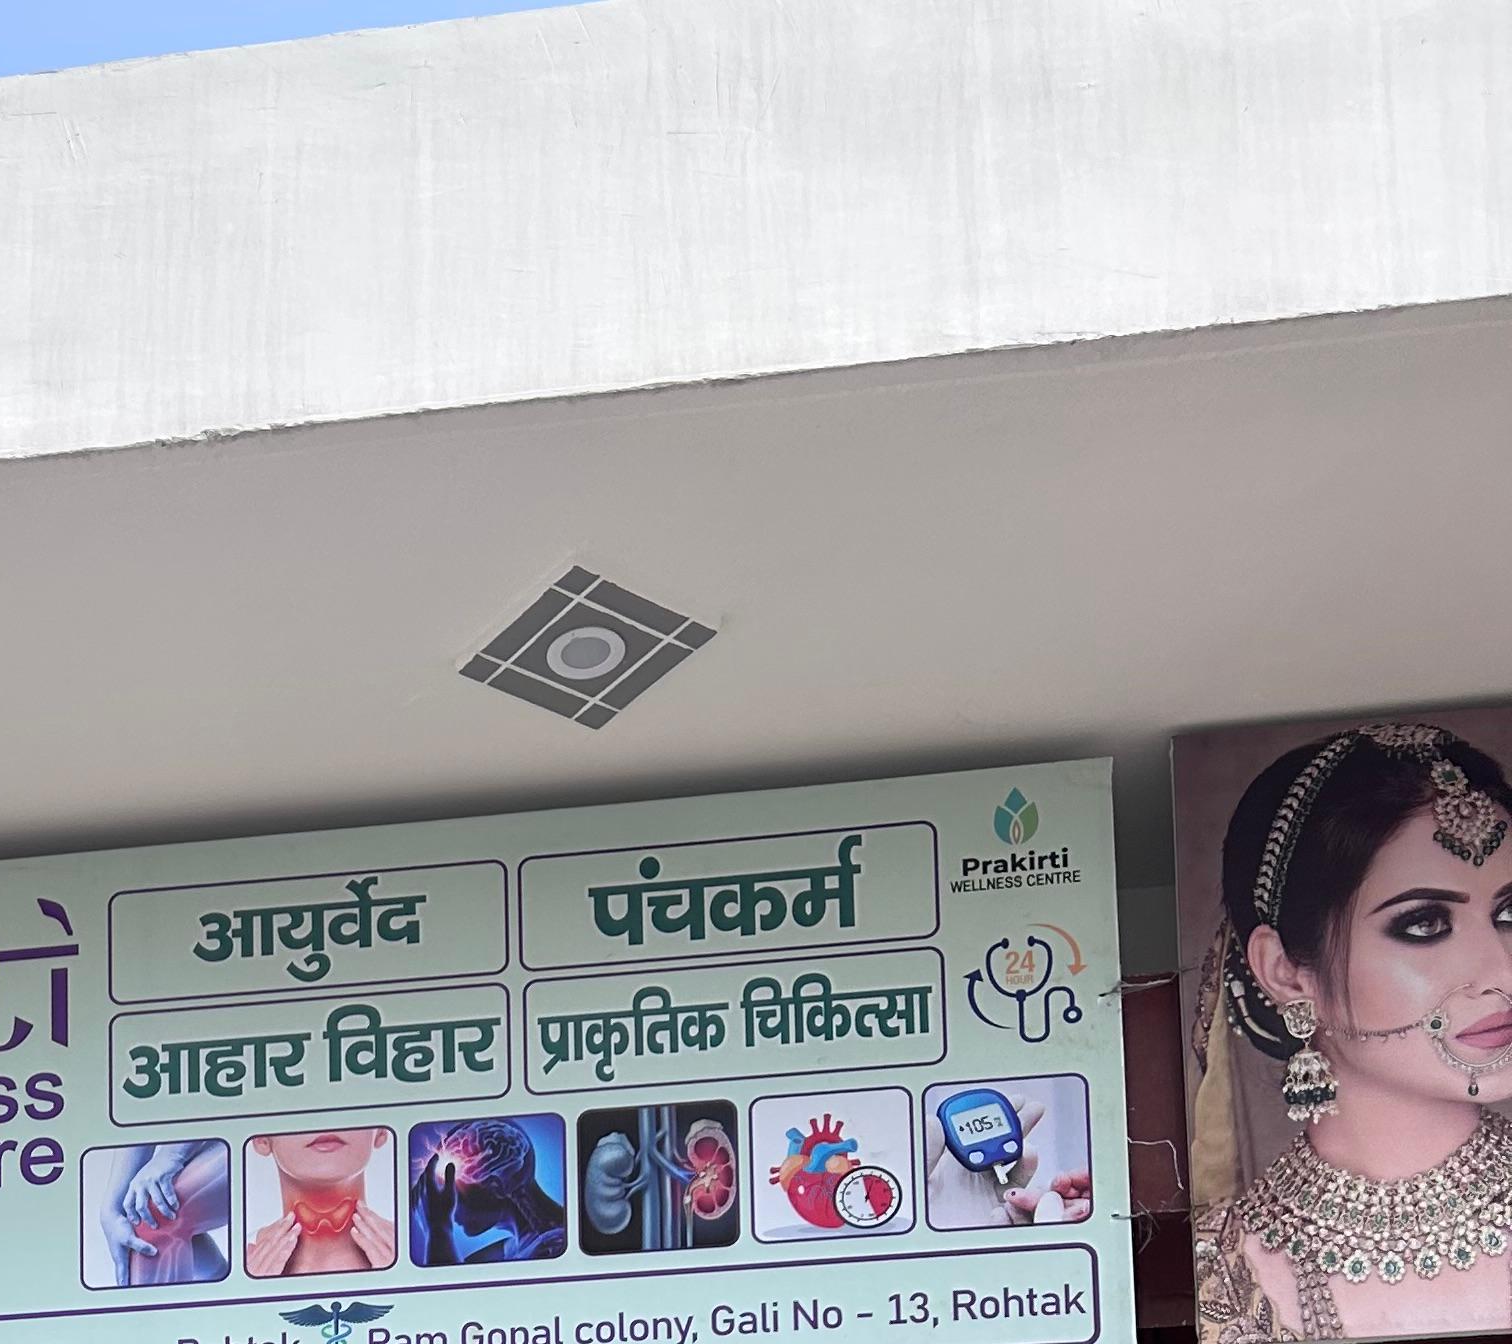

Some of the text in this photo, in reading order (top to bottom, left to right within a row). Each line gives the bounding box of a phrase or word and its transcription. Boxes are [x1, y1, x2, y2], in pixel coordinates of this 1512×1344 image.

[951, 871, 1080, 893] WELLNESS CENTRE
[963, 848, 1069, 876] Prakirti
[588, 835, 863, 945] पंचकर्म
[193, 876, 426, 981] आयुर्वेद
[1005, 950, 1035, 974] 24
[1006, 975, 1033, 984] HOUR
[123, 1004, 500, 1098] आहार विहार
[538, 973, 932, 1082] प्राकृतिक चिकित्सा
[712, 1302, 778, 1335] Gali
[793, 1299, 842, 1330] No
[889, 1293, 938, 1328] 13,
[953, 1284, 1086, 1321] Rohtak
